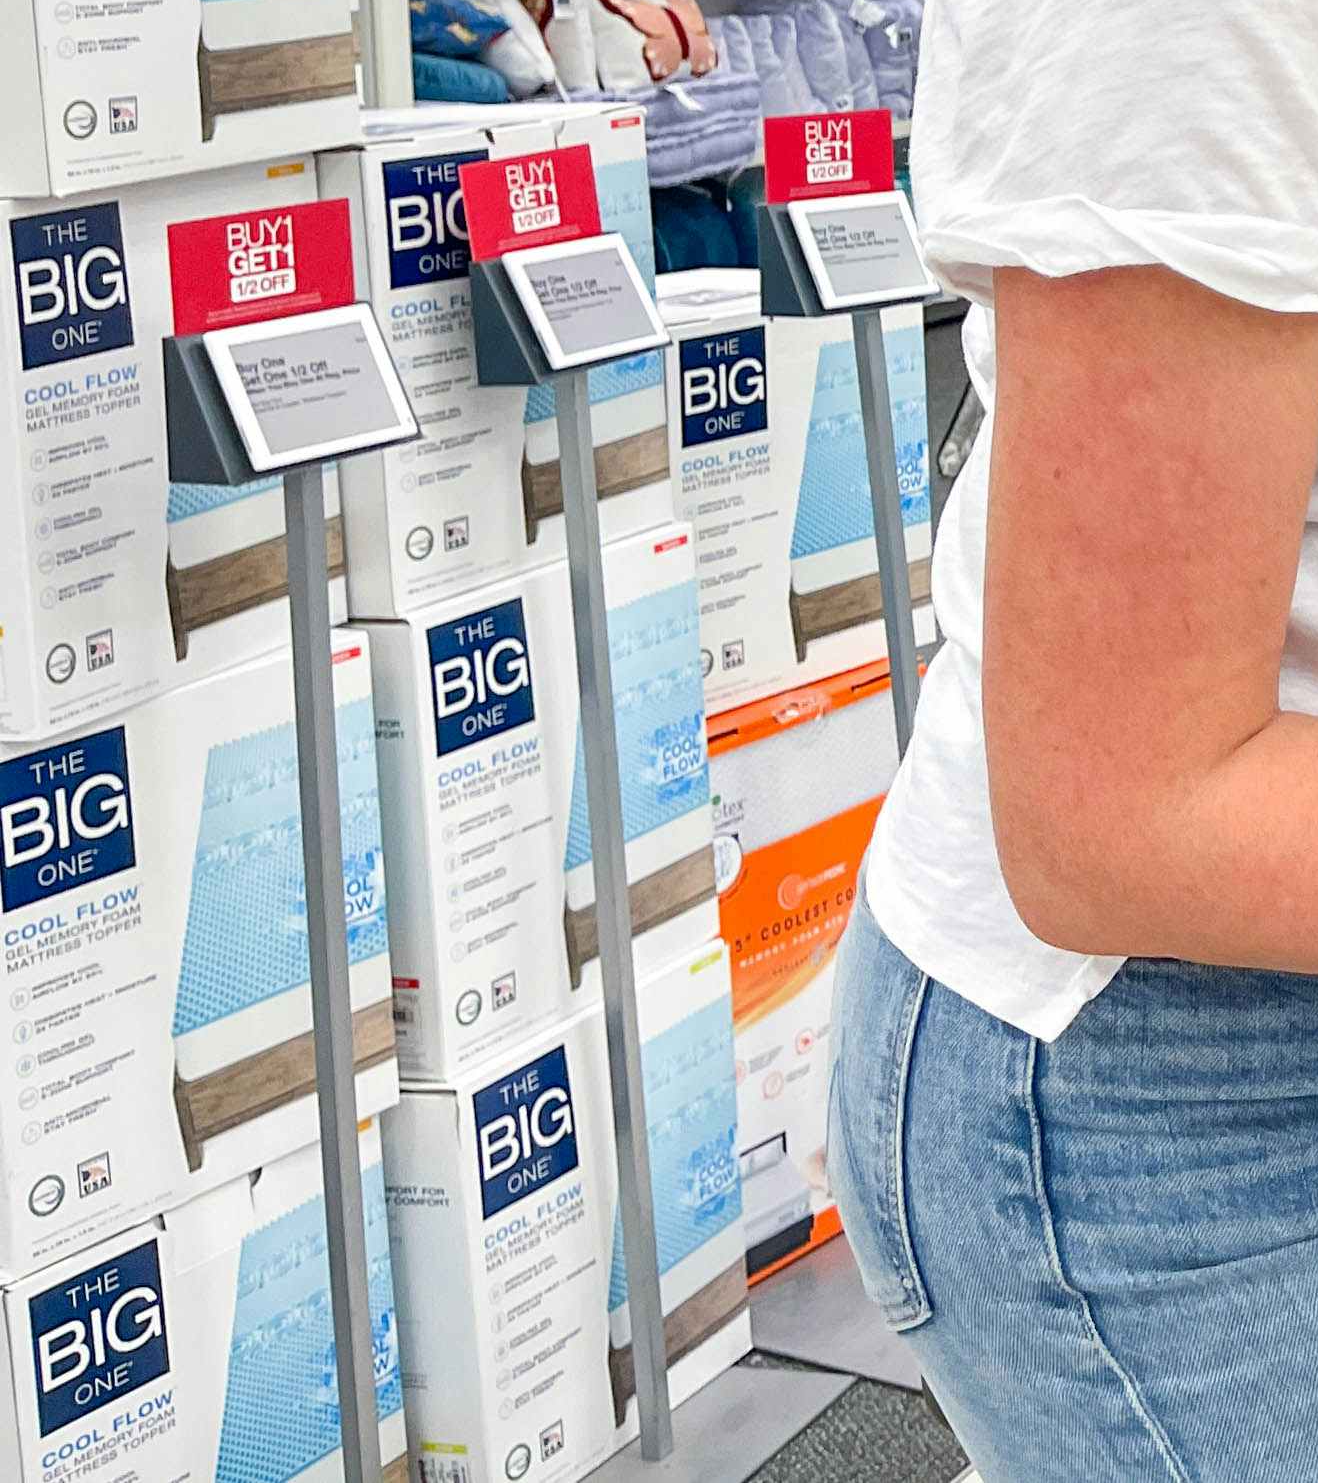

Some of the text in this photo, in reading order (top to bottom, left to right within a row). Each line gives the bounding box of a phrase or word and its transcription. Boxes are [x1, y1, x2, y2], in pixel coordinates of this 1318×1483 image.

[411, 162, 458, 186] THE
[828, 164, 848, 177] OFF
[42, 218, 88, 246] THE
[534, 209, 555, 224] OFF
[19, 246, 126, 326] BIG
[236, 274, 290, 296] 1/2 OFF
[391, 295, 471, 319] COOL FL
[52, 321, 100, 351] ONE
[703, 337, 740, 360] THE
[25, 365, 138, 406] COOL FLOW
[52, 392, 104, 414] MEMORY
[107, 382, 141, 399] FOAM
[683, 357, 766, 417] BIG
[27, 396, 142, 434] MATTRESS TOPPER
[682, 443, 770, 475] COOL FLOW
[454, 617, 496, 646] THE
[434, 637, 530, 719] BIG
[29, 749, 86, 784] THE
[438, 738, 539, 789] COOL FLOW
[663, 736, 701, 763] COOL
[663, 748, 701, 781] FLOW
[0, 773, 129, 868] BIG
[37, 850, 96, 887] ONE
[346, 876, 374, 897] OL
[4, 887, 140, 947] COOL FLOW
[5, 902, 142, 961] GEL MEMORY FOAM
[761, 900, 829, 943] COOLEST
[6, 916, 142, 975] MATTRESS TOPPER
[499, 1069, 541, 1105] THE
[479, 1086, 573, 1182] BIG
[484, 1182, 583, 1251] COOL FLOW
[66, 1268, 121, 1309] THE
[38, 1286, 163, 1394] BIG
[74, 1361, 134, 1406] ONE
[42, 1390, 174, 1469] COOL FLOW
[73, 1430, 134, 1472] MEMORY
[138, 1406, 176, 1434] FOAM
[49, 1451, 118, 1483] ATTRESS
[122, 1419, 177, 1455] TOPPER
